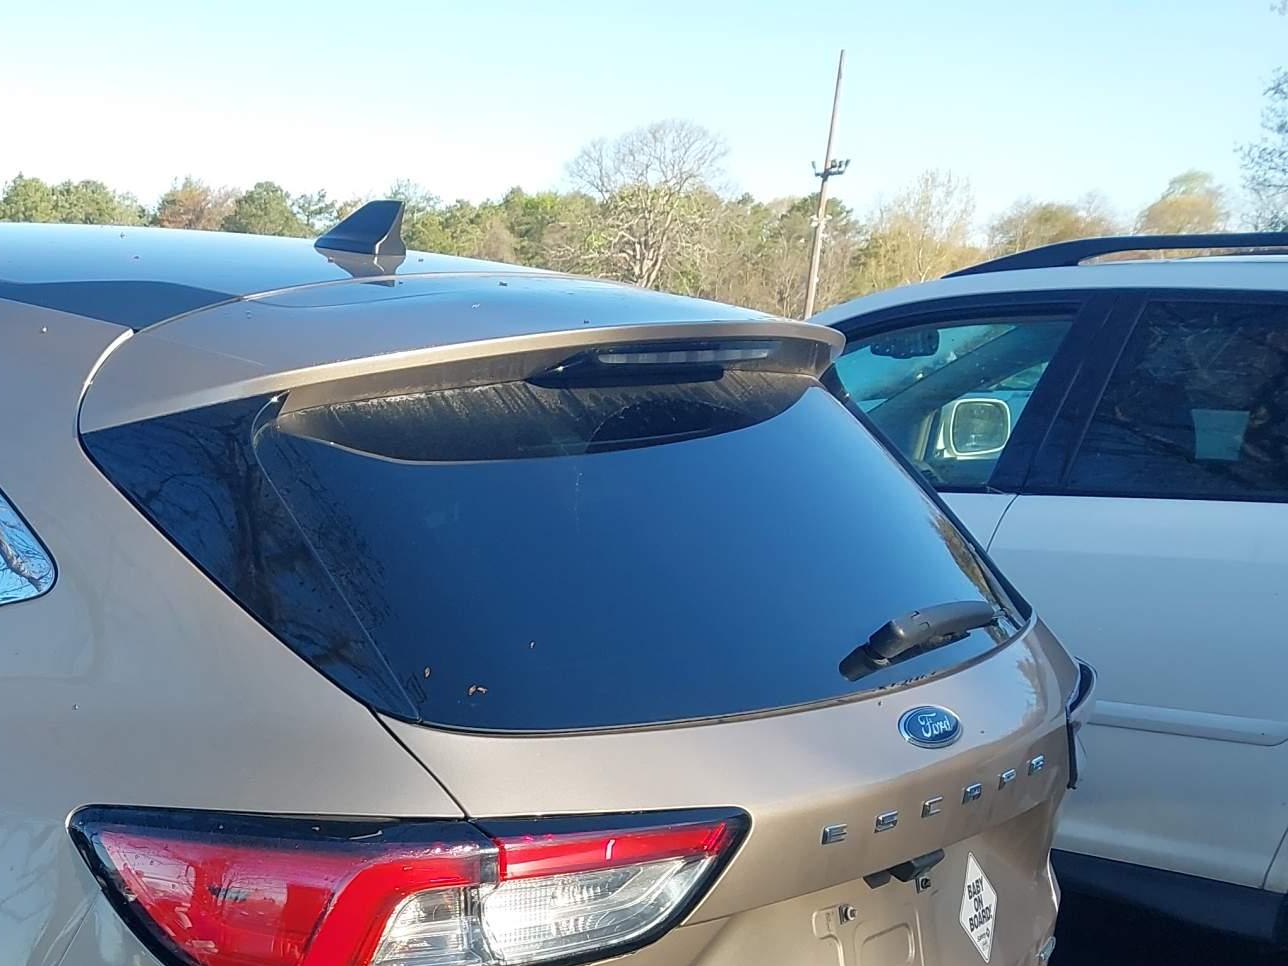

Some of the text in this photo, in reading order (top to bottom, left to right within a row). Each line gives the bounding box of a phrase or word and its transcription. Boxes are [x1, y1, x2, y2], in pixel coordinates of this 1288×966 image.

[917, 712, 952, 738] Ford
[821, 754, 1045, 845] ESCAPE
[967, 875, 984, 900] BABY
[973, 893, 984, 912] ON
